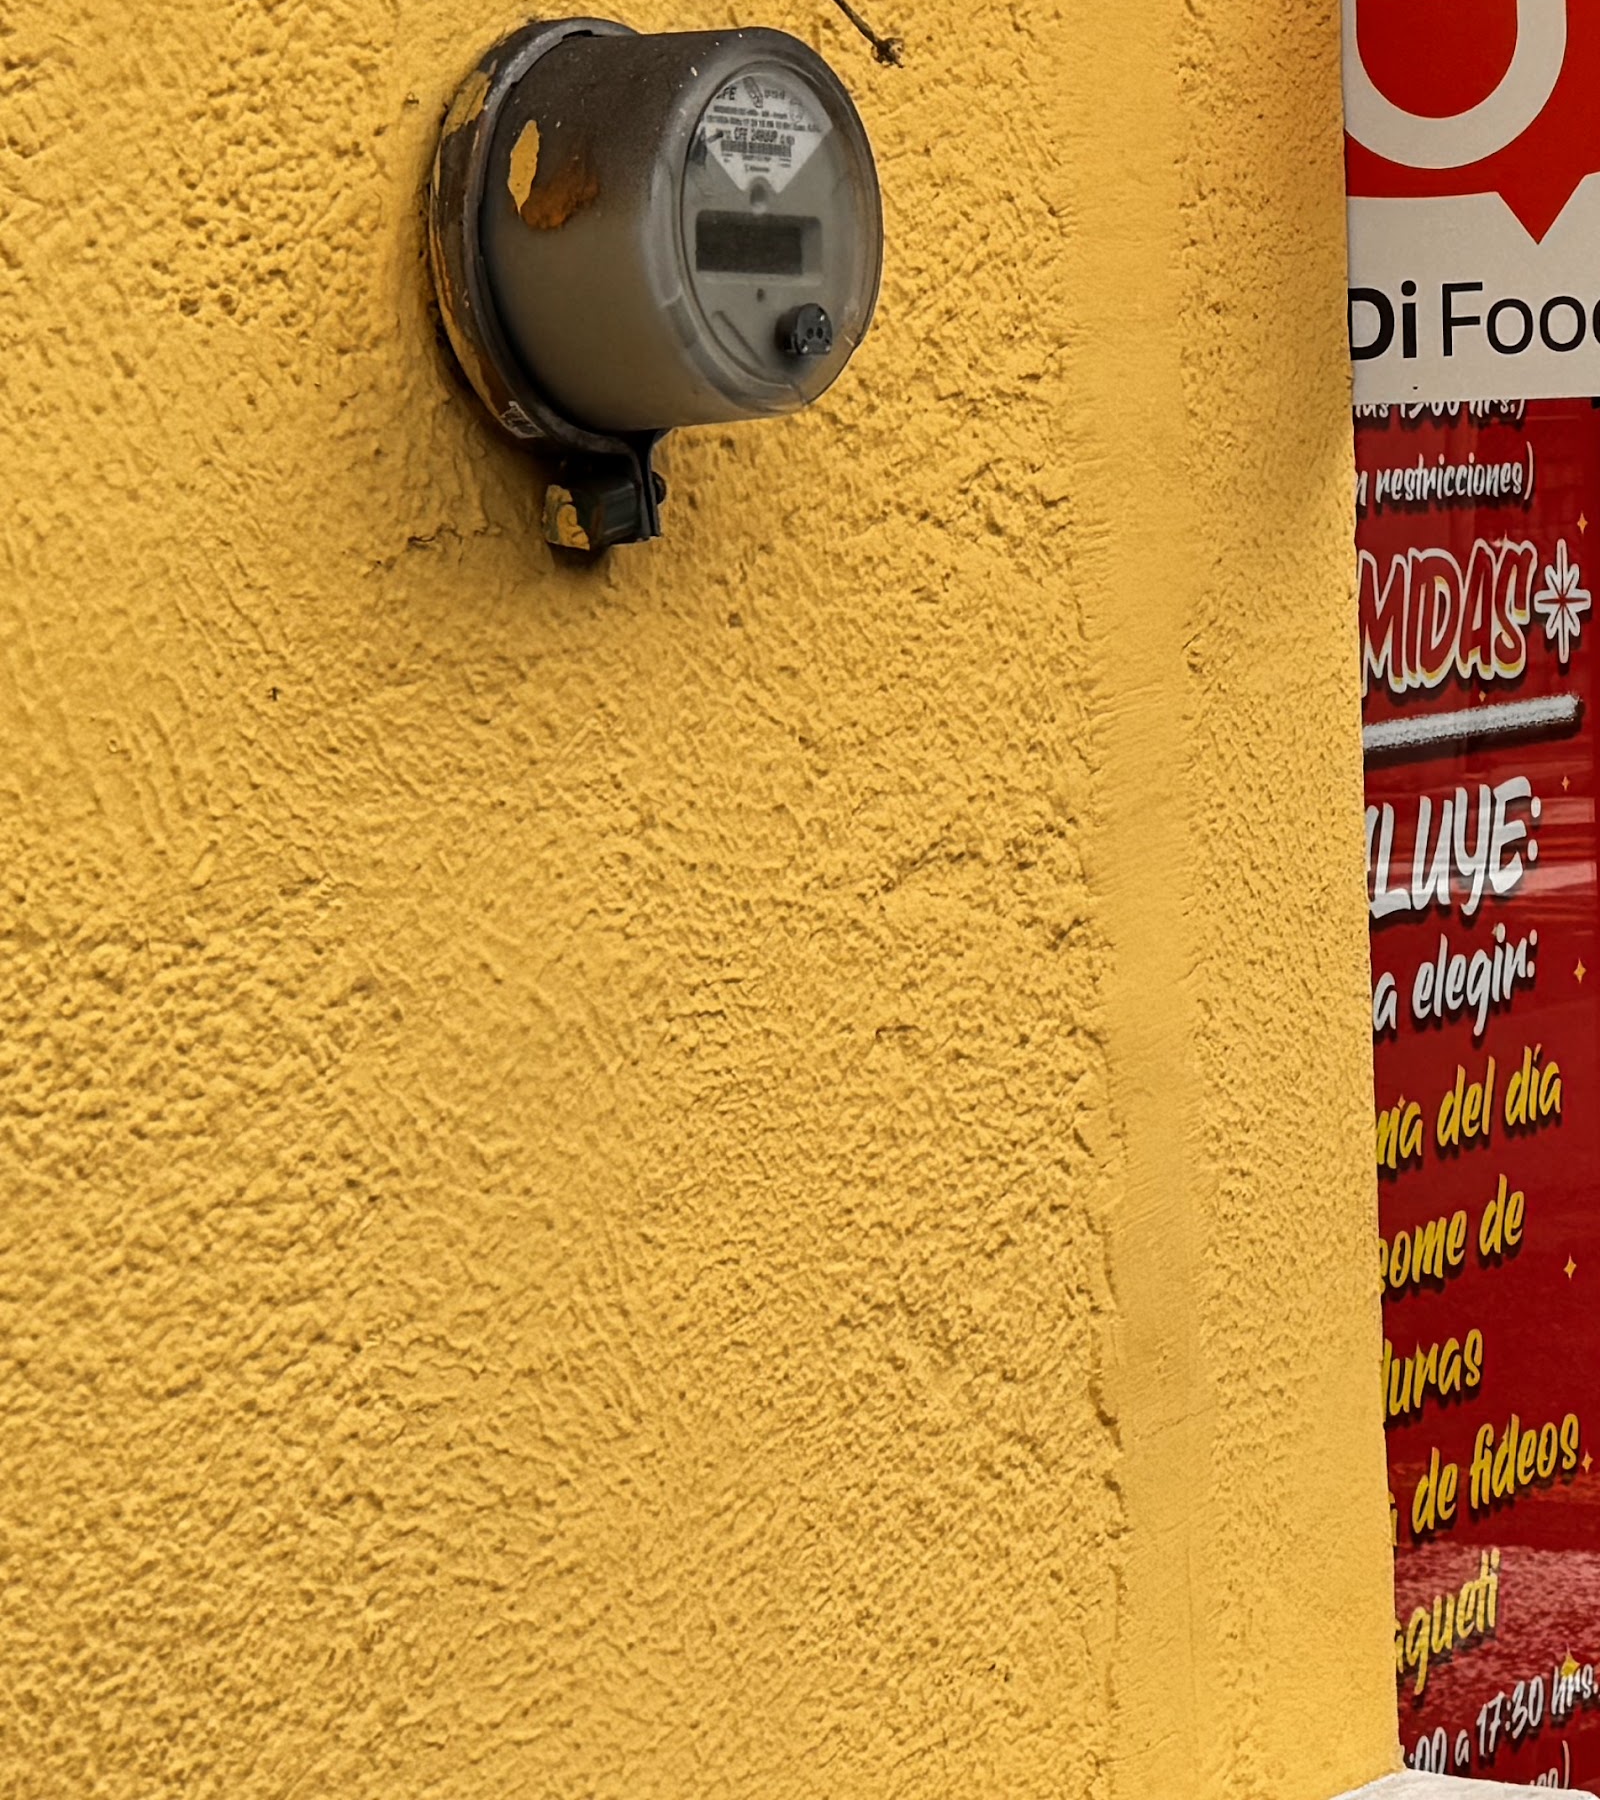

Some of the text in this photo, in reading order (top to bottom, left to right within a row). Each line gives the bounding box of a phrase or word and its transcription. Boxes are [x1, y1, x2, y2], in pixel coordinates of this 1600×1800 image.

[1375, 440, 1534, 504] restricciones)
[1412, 922, 1538, 1038] elegir:
[1437, 1055, 1496, 1147] del
[1504, 1043, 1562, 1126] día
[1479, 1173, 1524, 1256] de
[1412, 1446, 1458, 1534] de
[1470, 1413, 1579, 1510] fideos
[1454, 1729, 1470, 1767] a
[1476, 1675, 1545, 1756] 17:30
